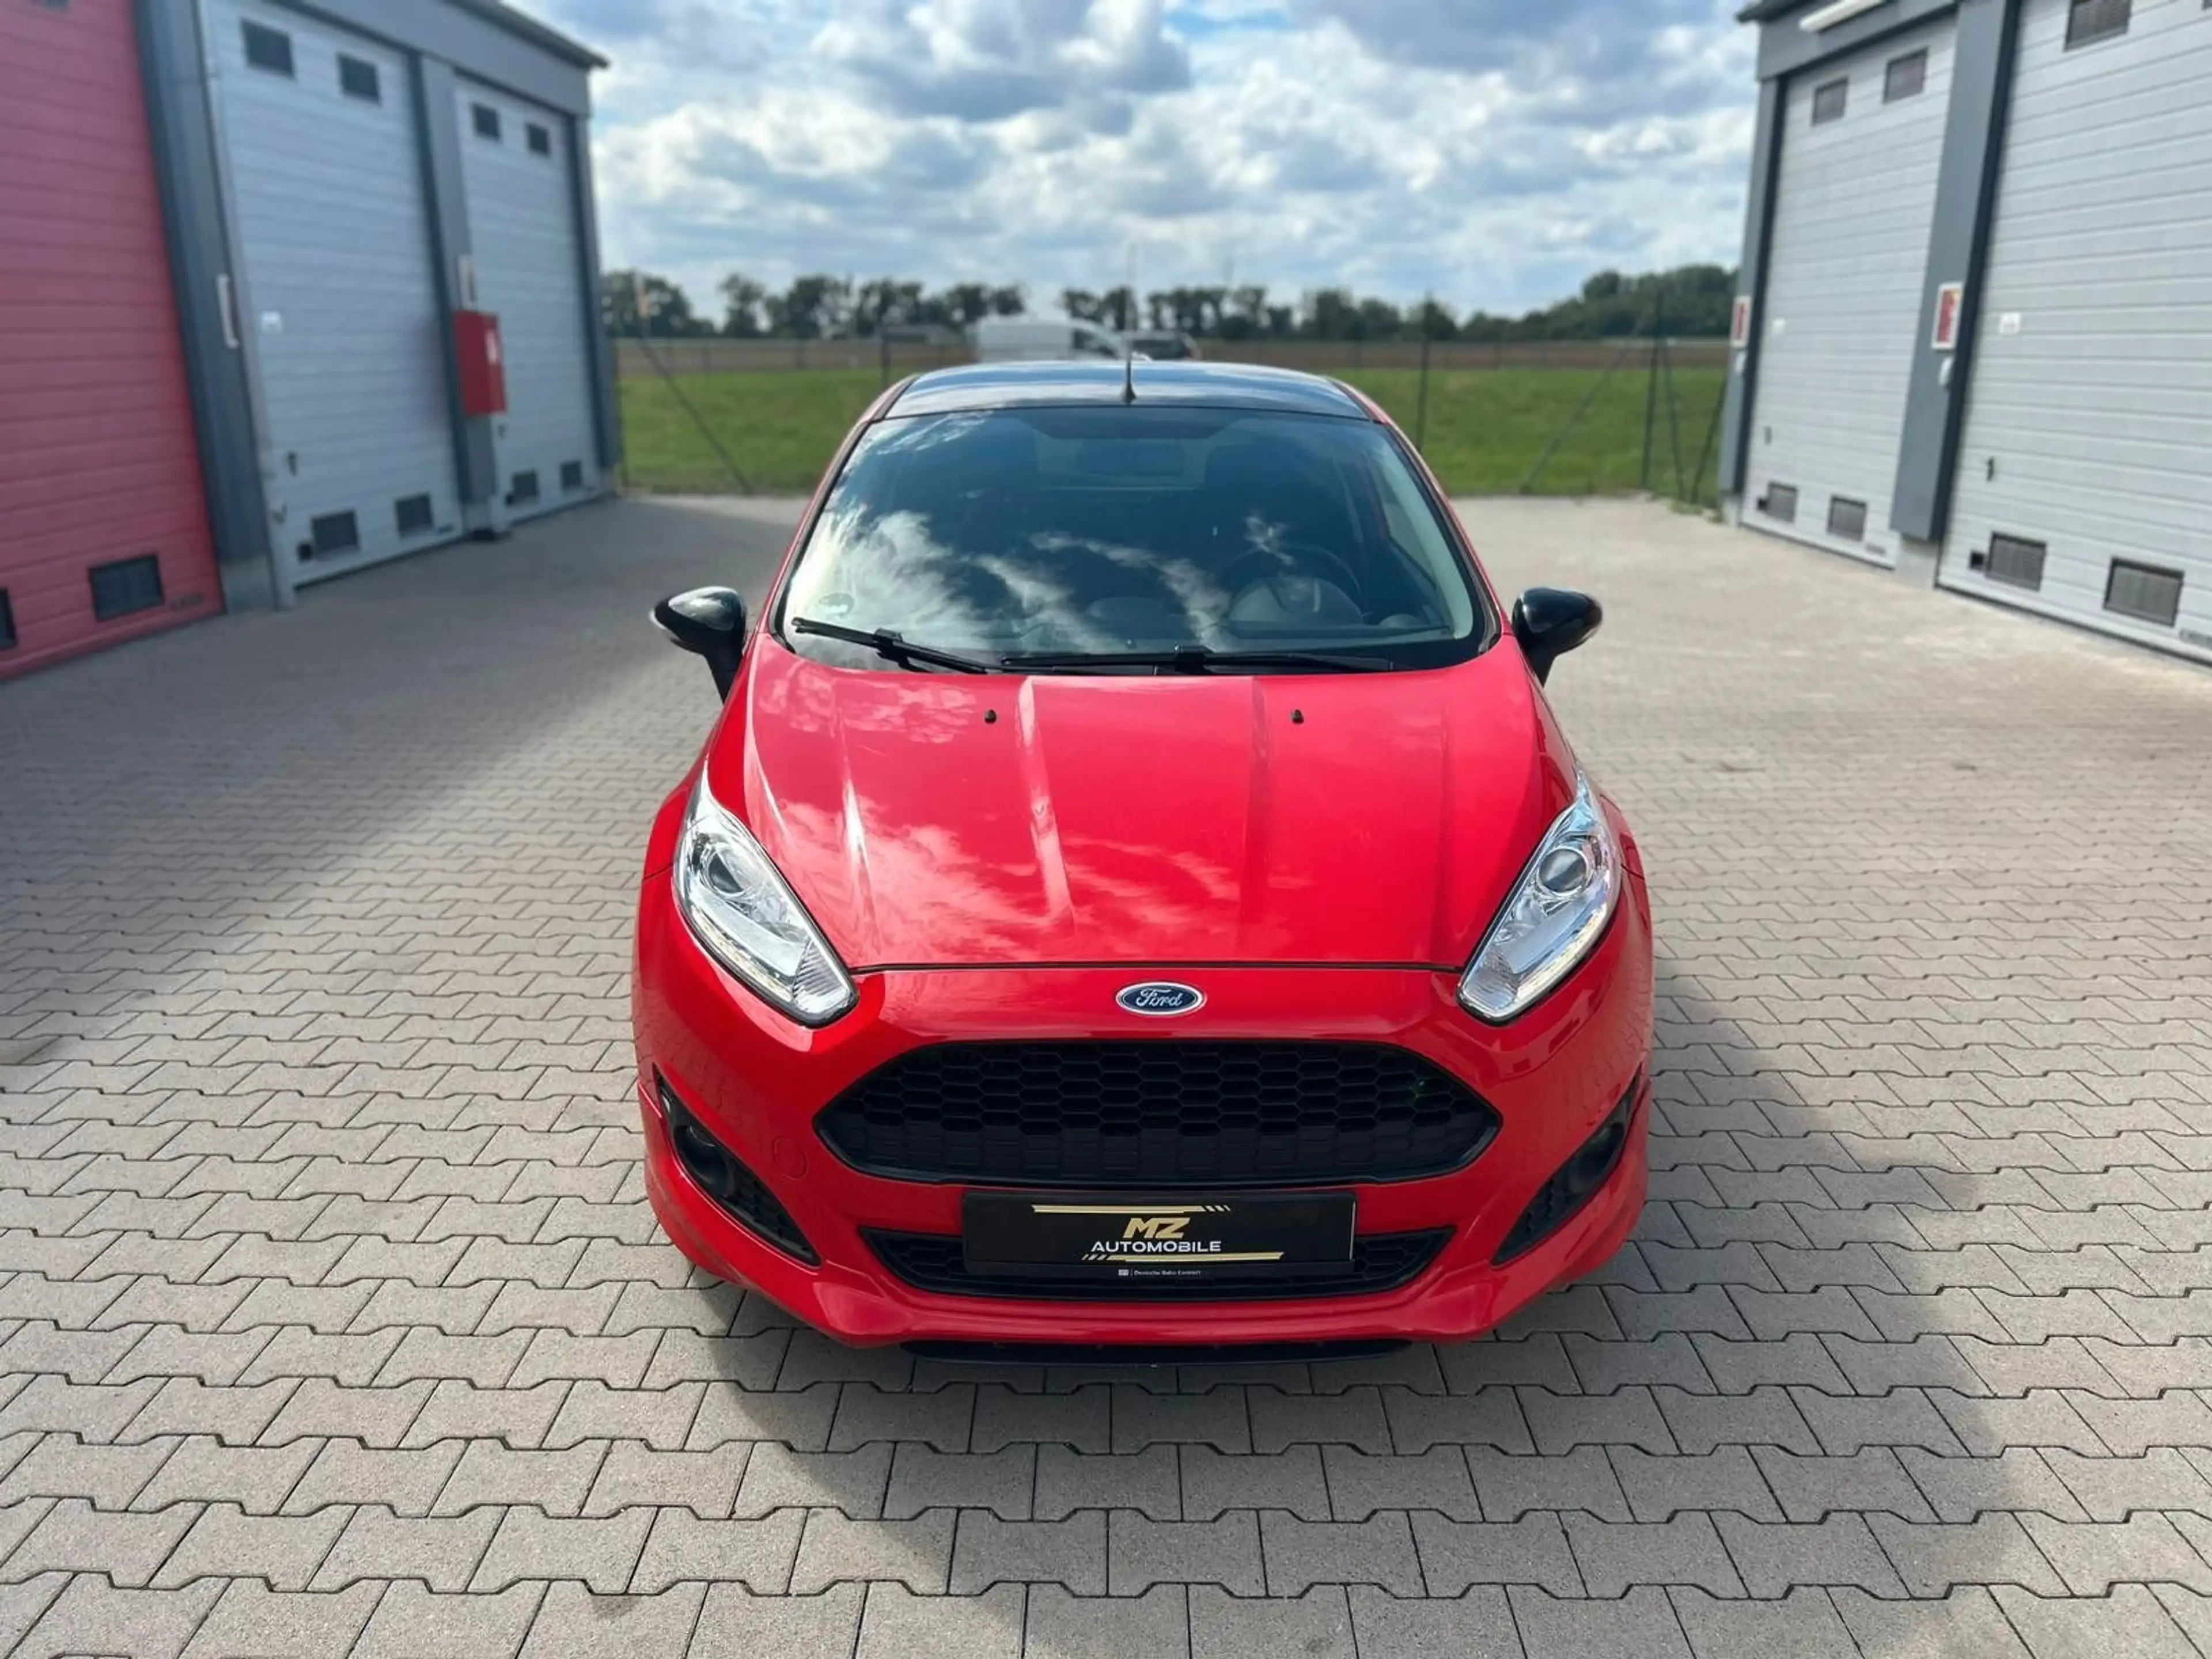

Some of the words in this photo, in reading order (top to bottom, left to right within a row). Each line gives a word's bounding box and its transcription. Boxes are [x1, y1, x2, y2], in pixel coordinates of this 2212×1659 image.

[1135, 988, 1183, 1007] Ford
[1122, 1217, 1191, 1239] MZ
[1090, 1240, 1222, 1253] AUTOMOBILE
